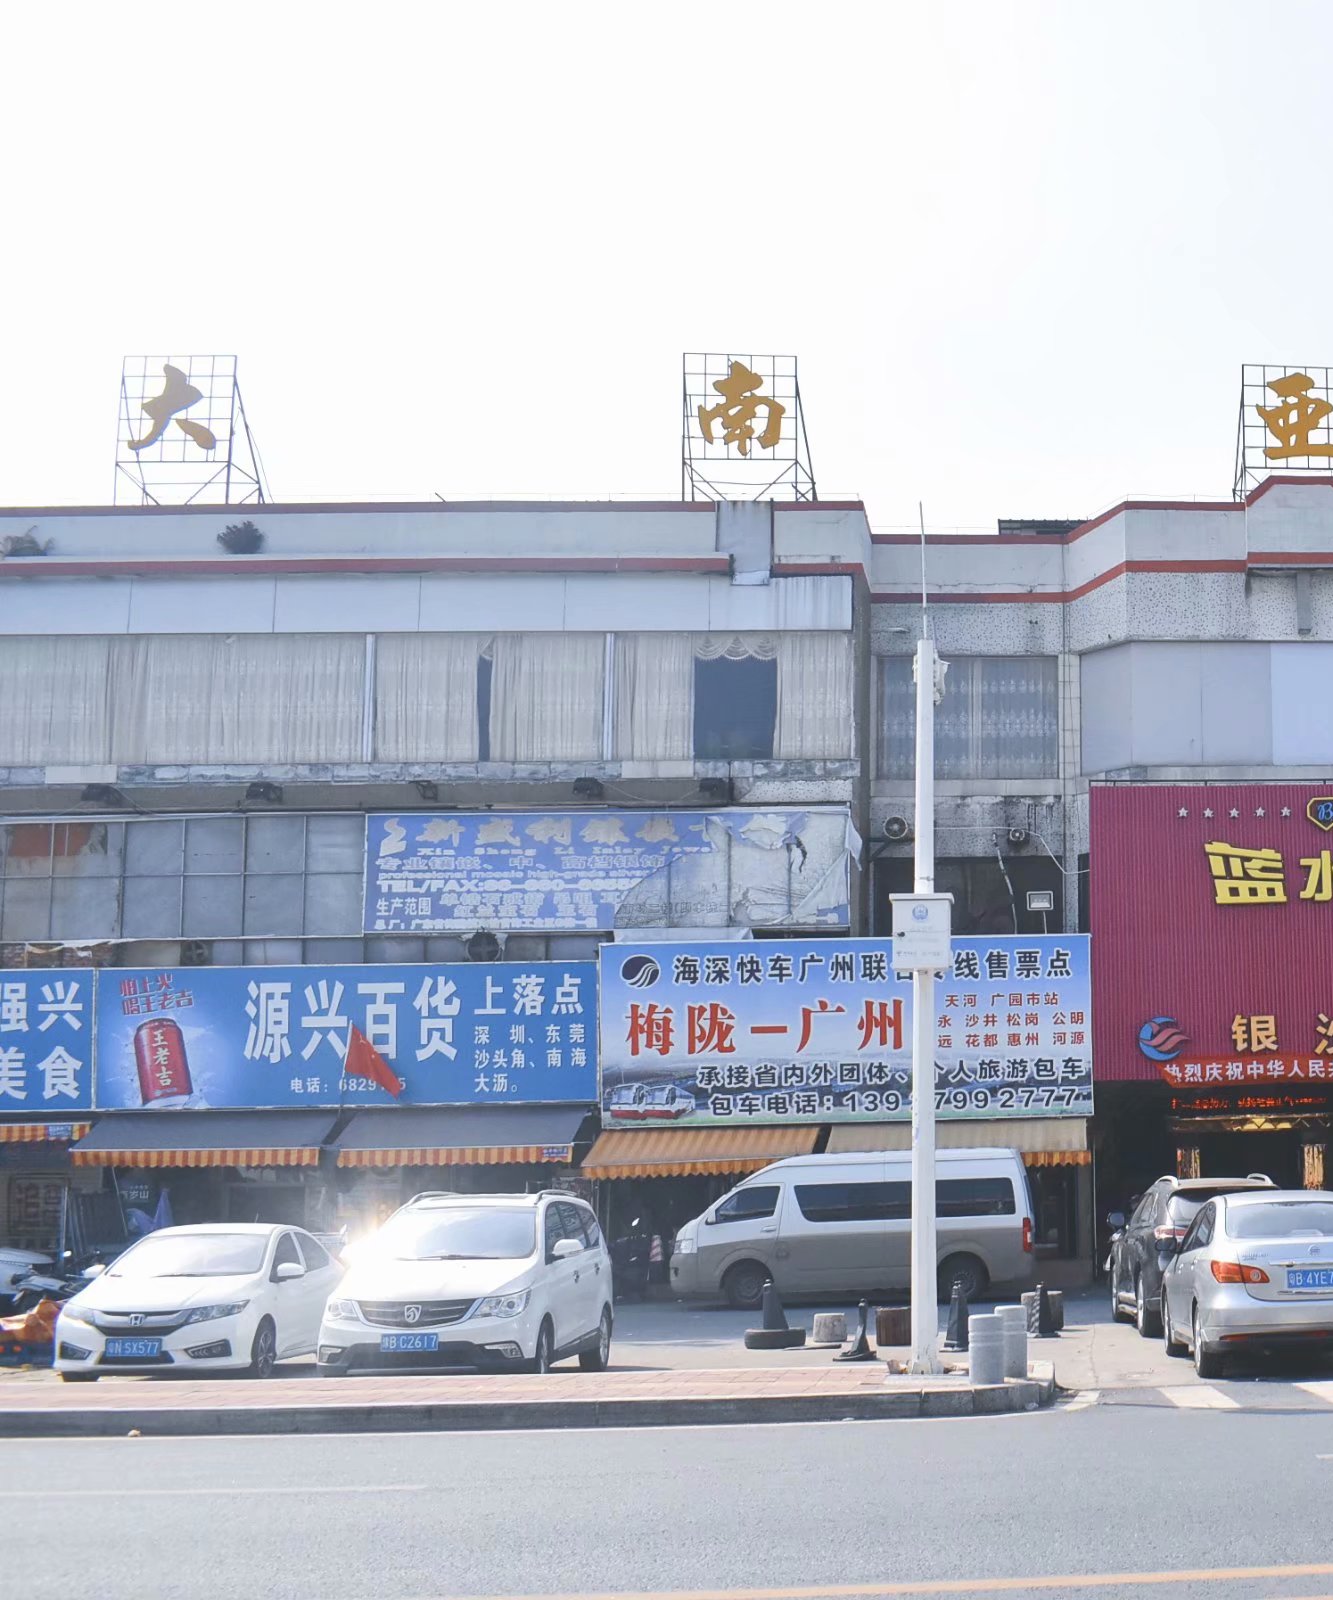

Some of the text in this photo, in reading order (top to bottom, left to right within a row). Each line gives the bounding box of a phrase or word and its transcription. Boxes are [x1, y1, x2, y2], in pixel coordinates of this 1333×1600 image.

[376, 897, 432, 915] 生产范围
[674, 950, 1072, 985] 海深快车广州联线售票点
[120, 973, 173, 997] 怕上火
[474, 973, 584, 1016] 上落点
[0, 981, 83, 1032] 强兴
[122, 989, 194, 1017] 喝王老吉
[945, 992, 1059, 1008] 天河 广园市站
[243, 976, 462, 1064] 源兴百货
[965, 1013, 998, 1027] 沙井
[1006, 1012, 1039, 1027] 松岗
[1052, 1011, 1084, 1025] 公明
[965, 1033, 998, 1047] 花都
[1006, 1032, 1039, 1047] 惠州
[1052, 1031, 1085, 1046] 河源
[152, 1028, 173, 1087] 王老吉
[474, 1048, 587, 1069] 沙头角、南海
[0, 1046, 84, 1100] 美食
[290, 1077, 406, 1094] 电话： 68295
[711, 1093, 832, 1116] 包车电话：
